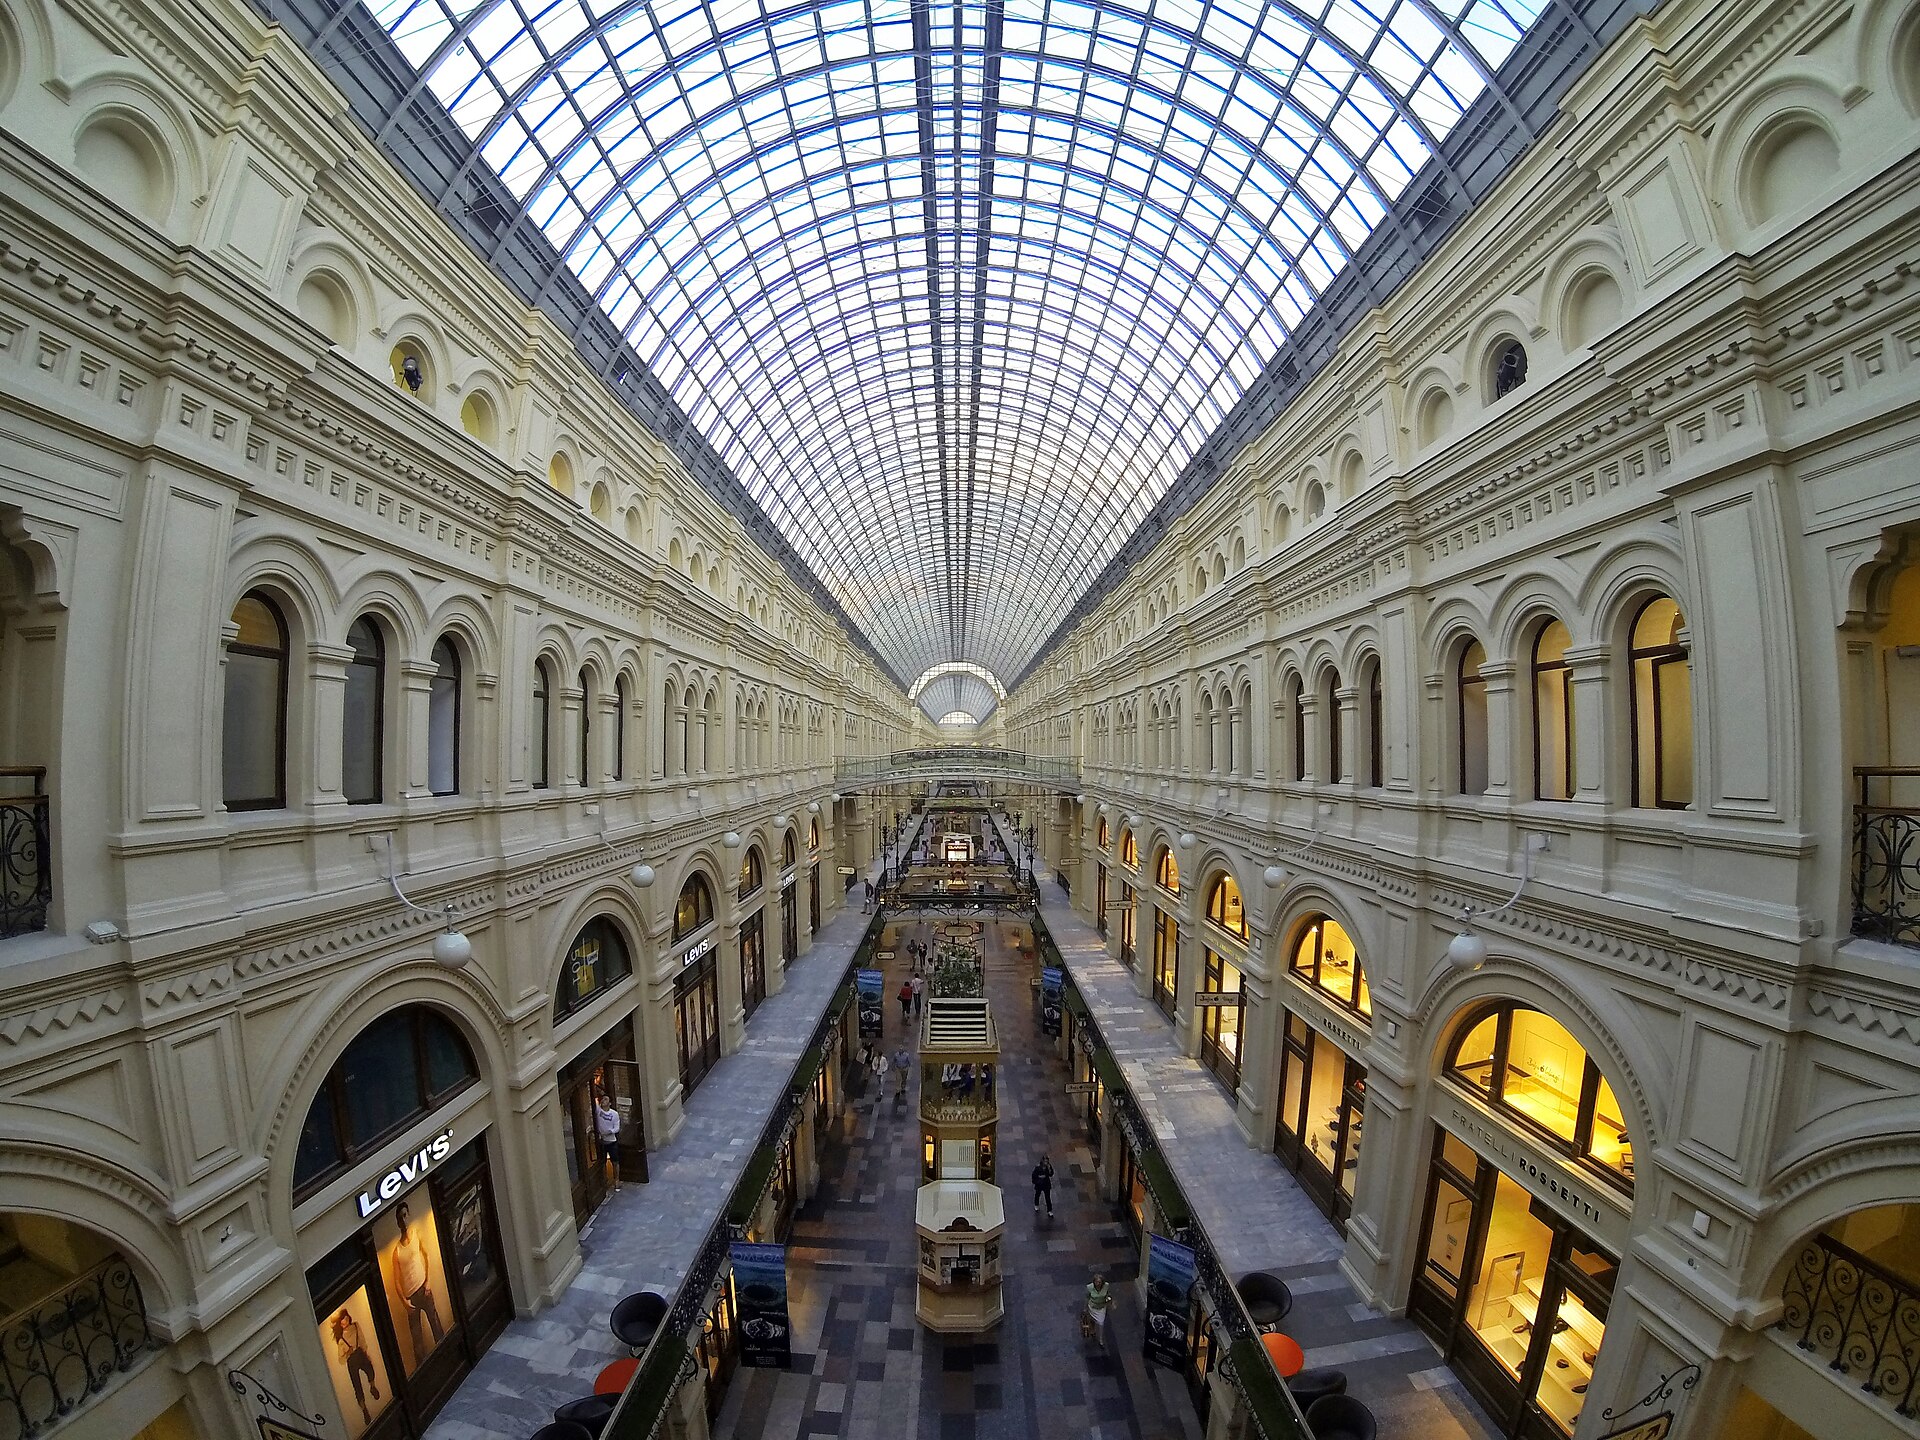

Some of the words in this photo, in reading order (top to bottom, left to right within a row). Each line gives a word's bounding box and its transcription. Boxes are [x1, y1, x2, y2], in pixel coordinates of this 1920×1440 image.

[1322, 1017, 1362, 1051] ROSSETTI
[1451, 1108, 1517, 1163] FRATELLI
[1518, 1156, 1601, 1224] ROSSETTI
[732, 1251, 785, 1263] OMEGA
